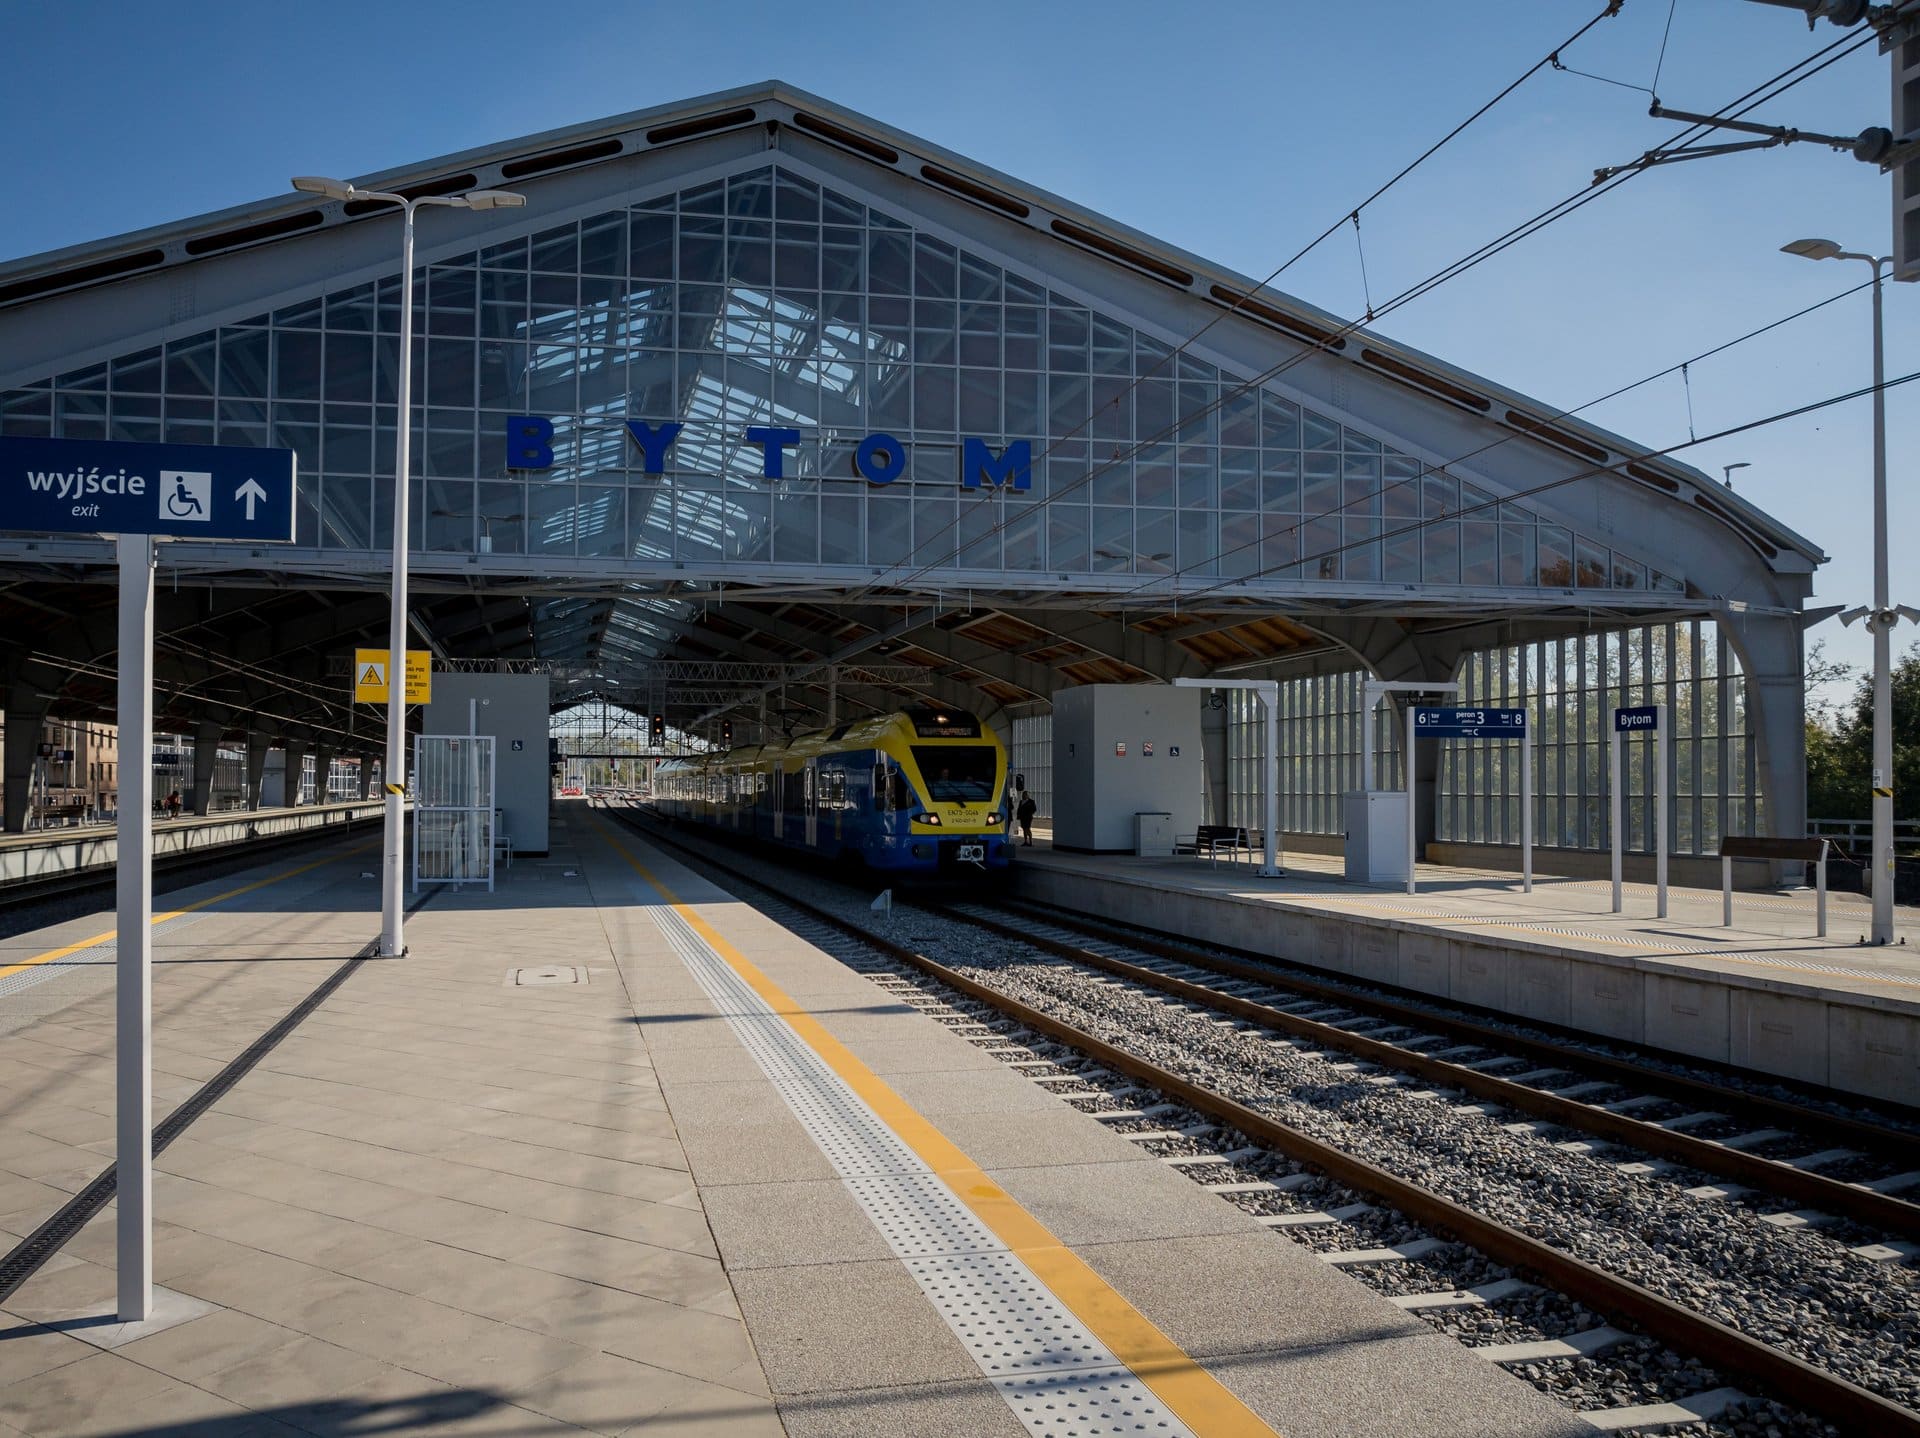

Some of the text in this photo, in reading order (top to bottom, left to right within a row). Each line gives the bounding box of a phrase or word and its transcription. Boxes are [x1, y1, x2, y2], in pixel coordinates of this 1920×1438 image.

[507, 415, 1032, 490] BYTOM
[27, 466, 146, 500] wyjście
[71, 504, 100, 518] exit
[1418, 713, 1427, 724] 6
[1456, 712, 1476, 720] peron
[1477, 711, 1485, 725] 3
[1514, 714, 1522, 725] 8
[1620, 714, 1652, 728] Bytom
[1473, 728, 1479, 736] C
